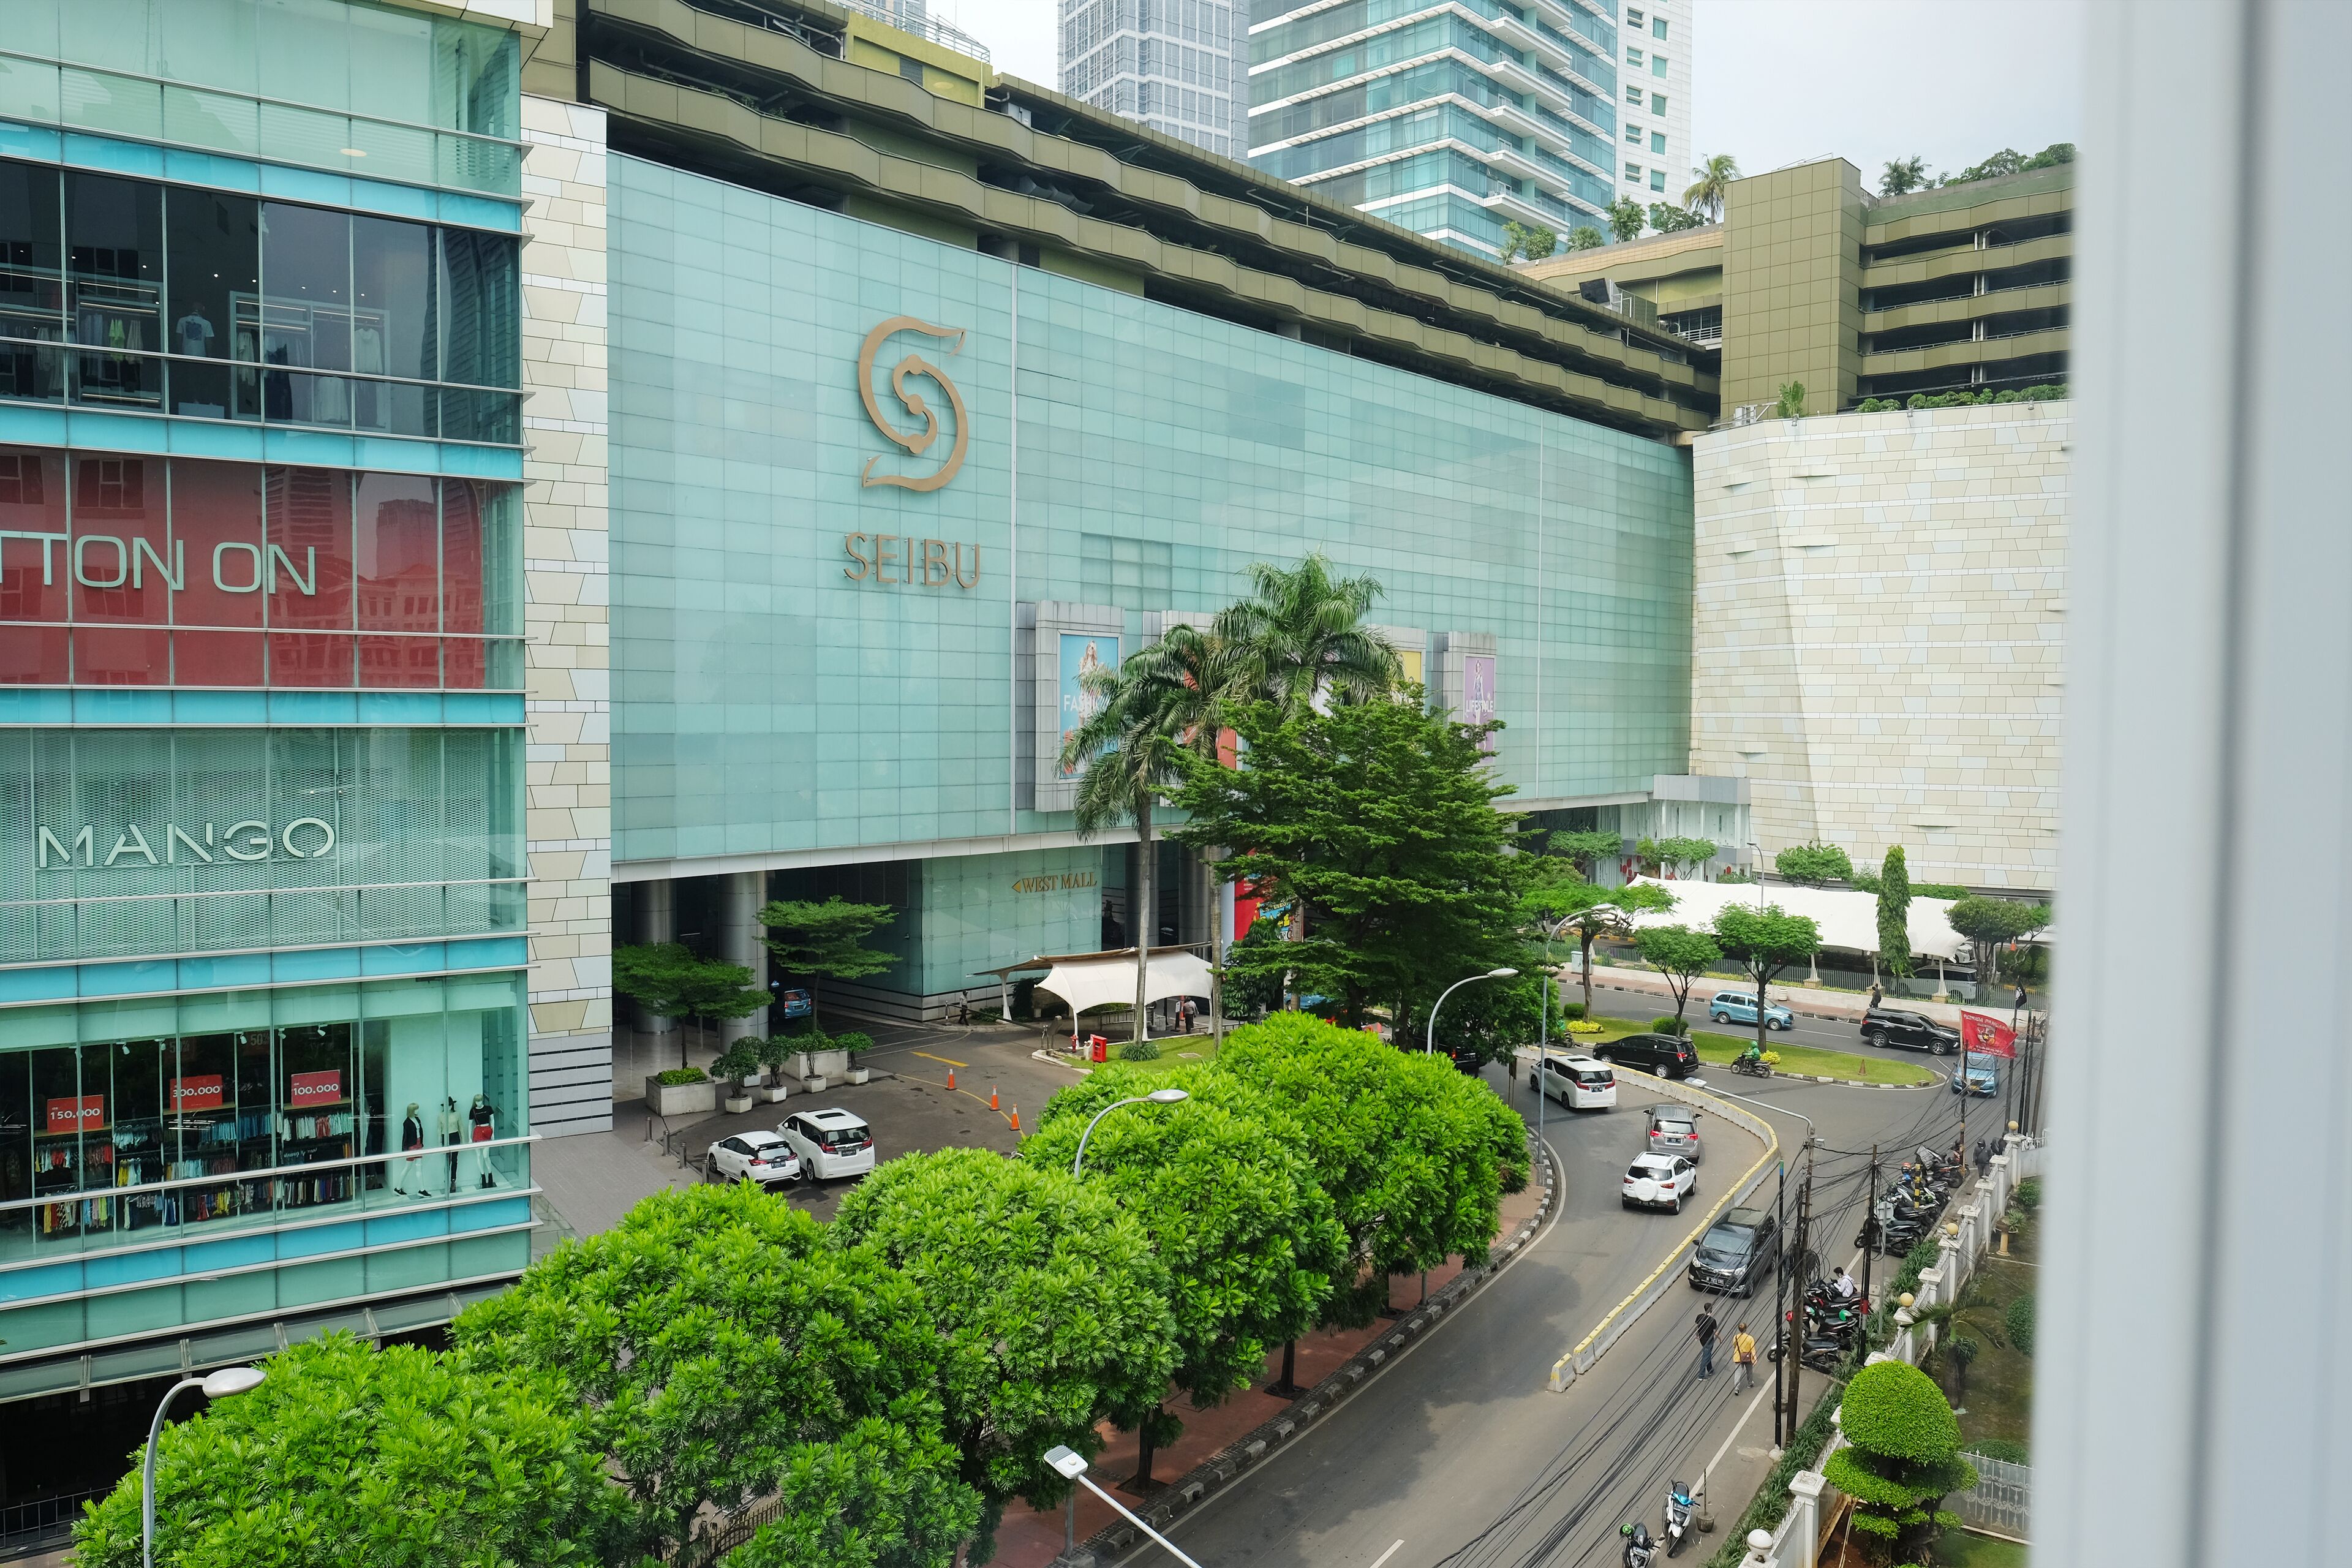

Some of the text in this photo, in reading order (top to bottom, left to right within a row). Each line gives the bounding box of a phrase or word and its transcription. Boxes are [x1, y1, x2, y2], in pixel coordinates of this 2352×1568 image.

[213, 541, 316, 596] ON
[843, 531, 981, 589] SEIBU
[1466, 699, 1493, 713] LIFESTYLE
[38, 816, 336, 869] MANGO
[1022, 872, 1098, 894] WEST MALL
